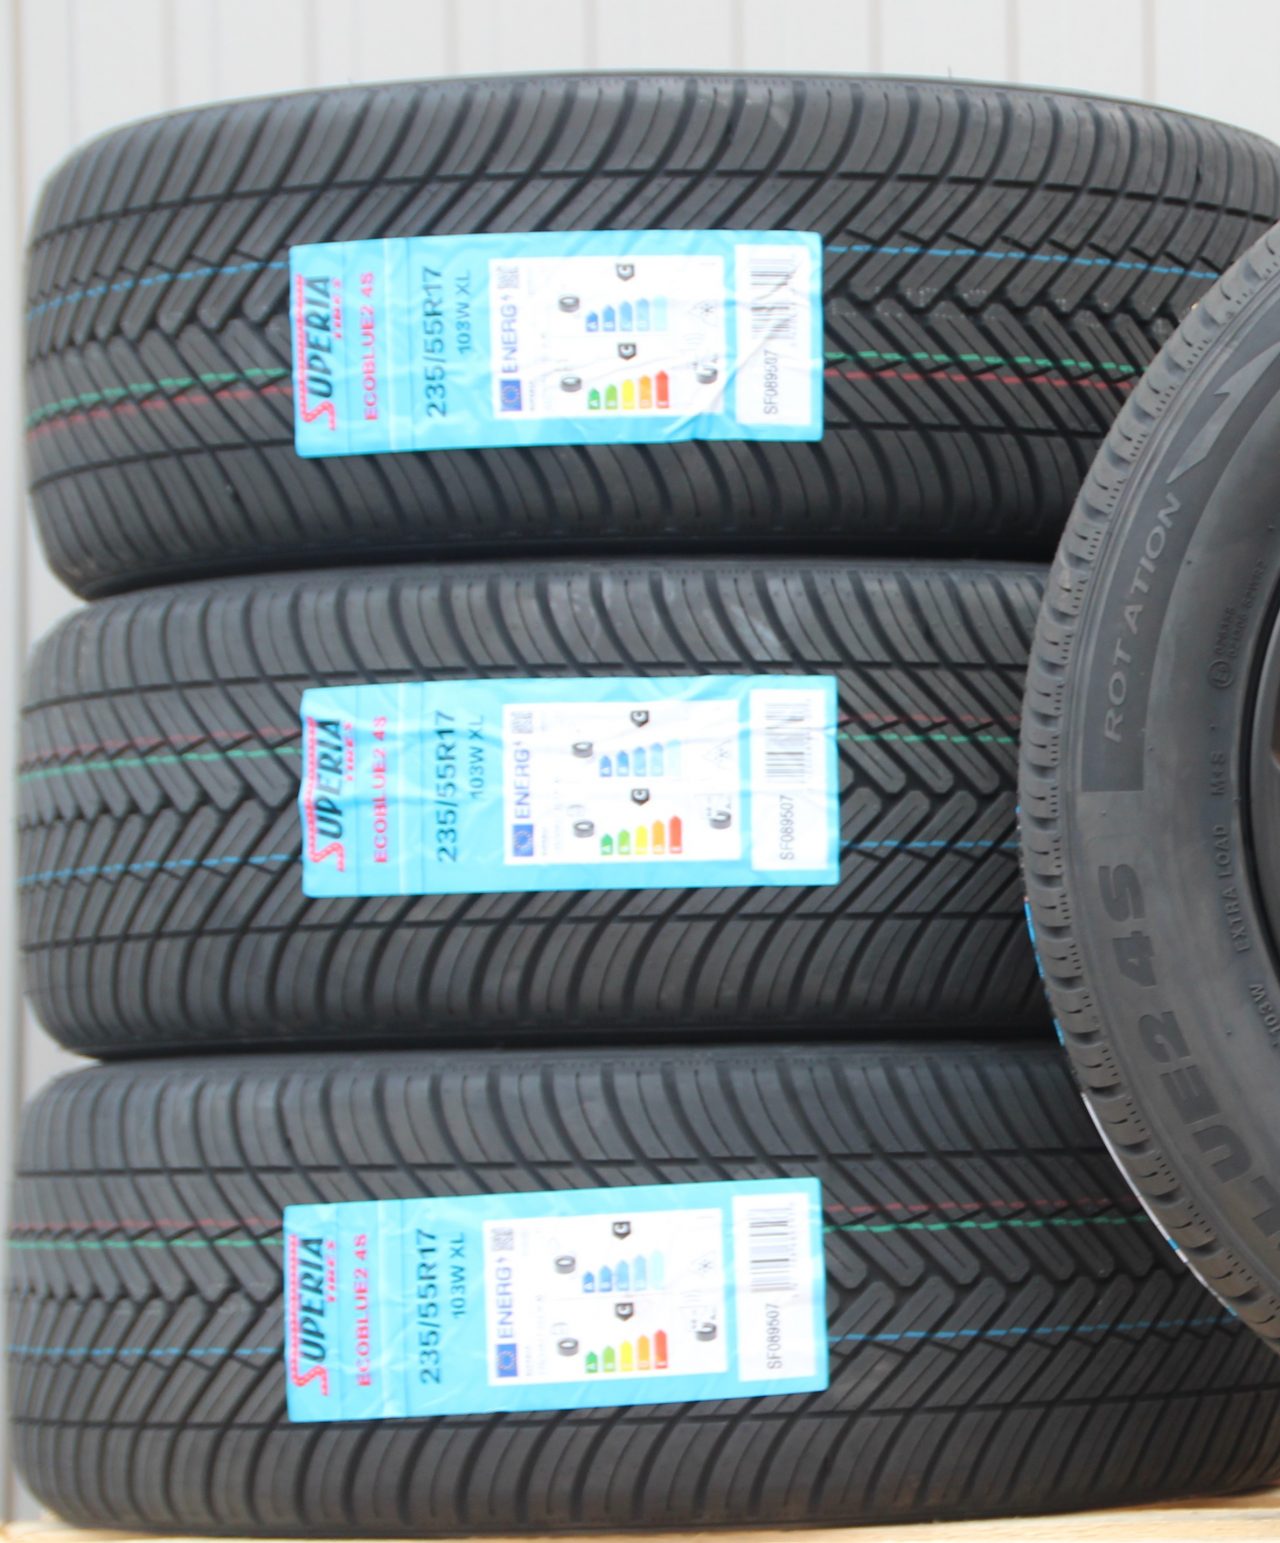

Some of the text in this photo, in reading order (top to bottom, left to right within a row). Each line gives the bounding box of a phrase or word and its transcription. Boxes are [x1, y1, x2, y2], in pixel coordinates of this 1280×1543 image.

[296, 274, 336, 431] SUPERIA
[360, 272, 379, 421] ECOBLUE2 4S
[422, 266, 447, 418] 235/55R17
[455, 270, 472, 354] 103W XL
[501, 305, 518, 374] ENERG
[304, 716, 345, 872] SUPERIA
[371, 716, 389, 863] ECOBLUE2 4S
[435, 710, 459, 863] 235/55R17
[469, 715, 485, 800] 103W XL
[514, 749, 531, 820] ENERG
[1096, 859, 1165, 996] 4S
[1211, 822, 1252, 955] EXTRA LOAD
[289, 1234, 329, 1396] SUPERIA
[353, 1234, 372, 1387] ECOBLUE2 4S
[417, 1228, 441, 1385] 235/55R17
[449, 1232, 467, 1319] 103W XL
[496, 1266, 514, 1339] ENERG
